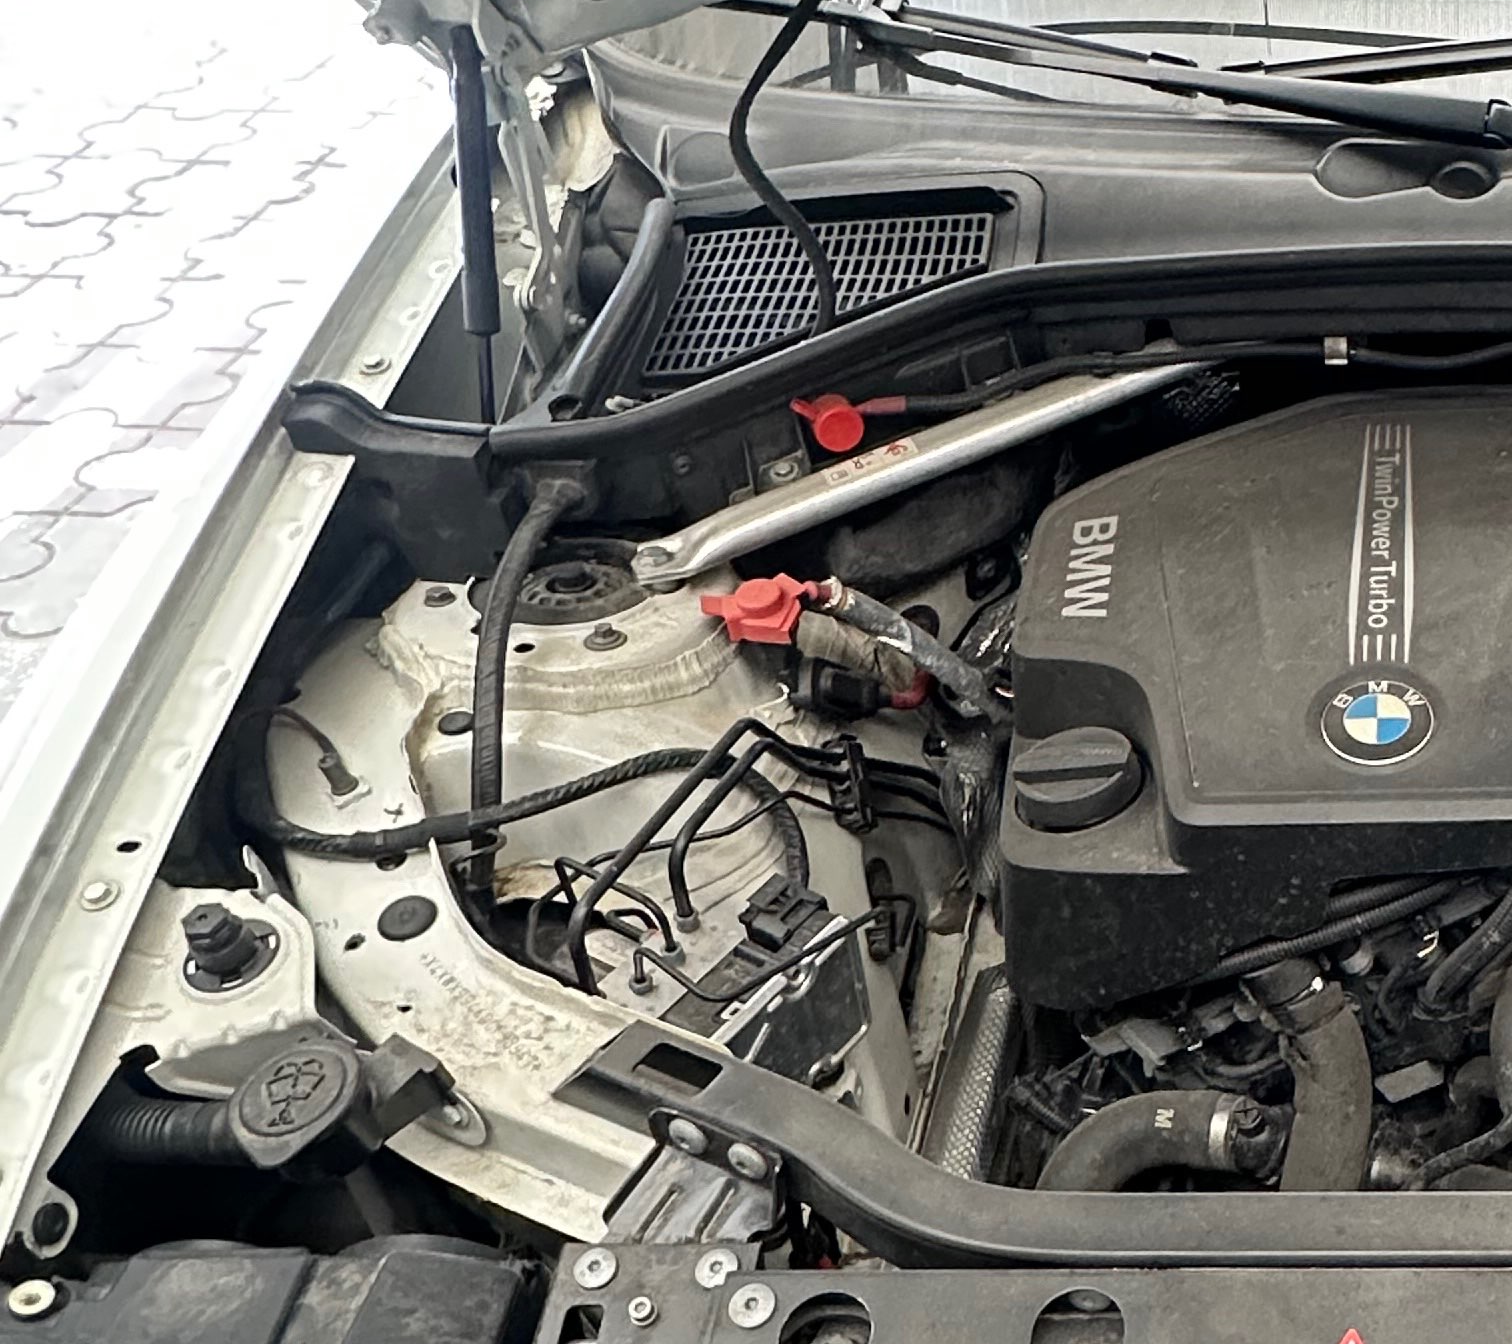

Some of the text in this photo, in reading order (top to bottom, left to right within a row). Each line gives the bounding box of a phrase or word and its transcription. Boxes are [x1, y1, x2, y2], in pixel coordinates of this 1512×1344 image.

[1061, 515, 1119, 617] BMW
[1367, 452, 1400, 628] TwinPower Turbo
[1332, 680, 1428, 709] BMW
